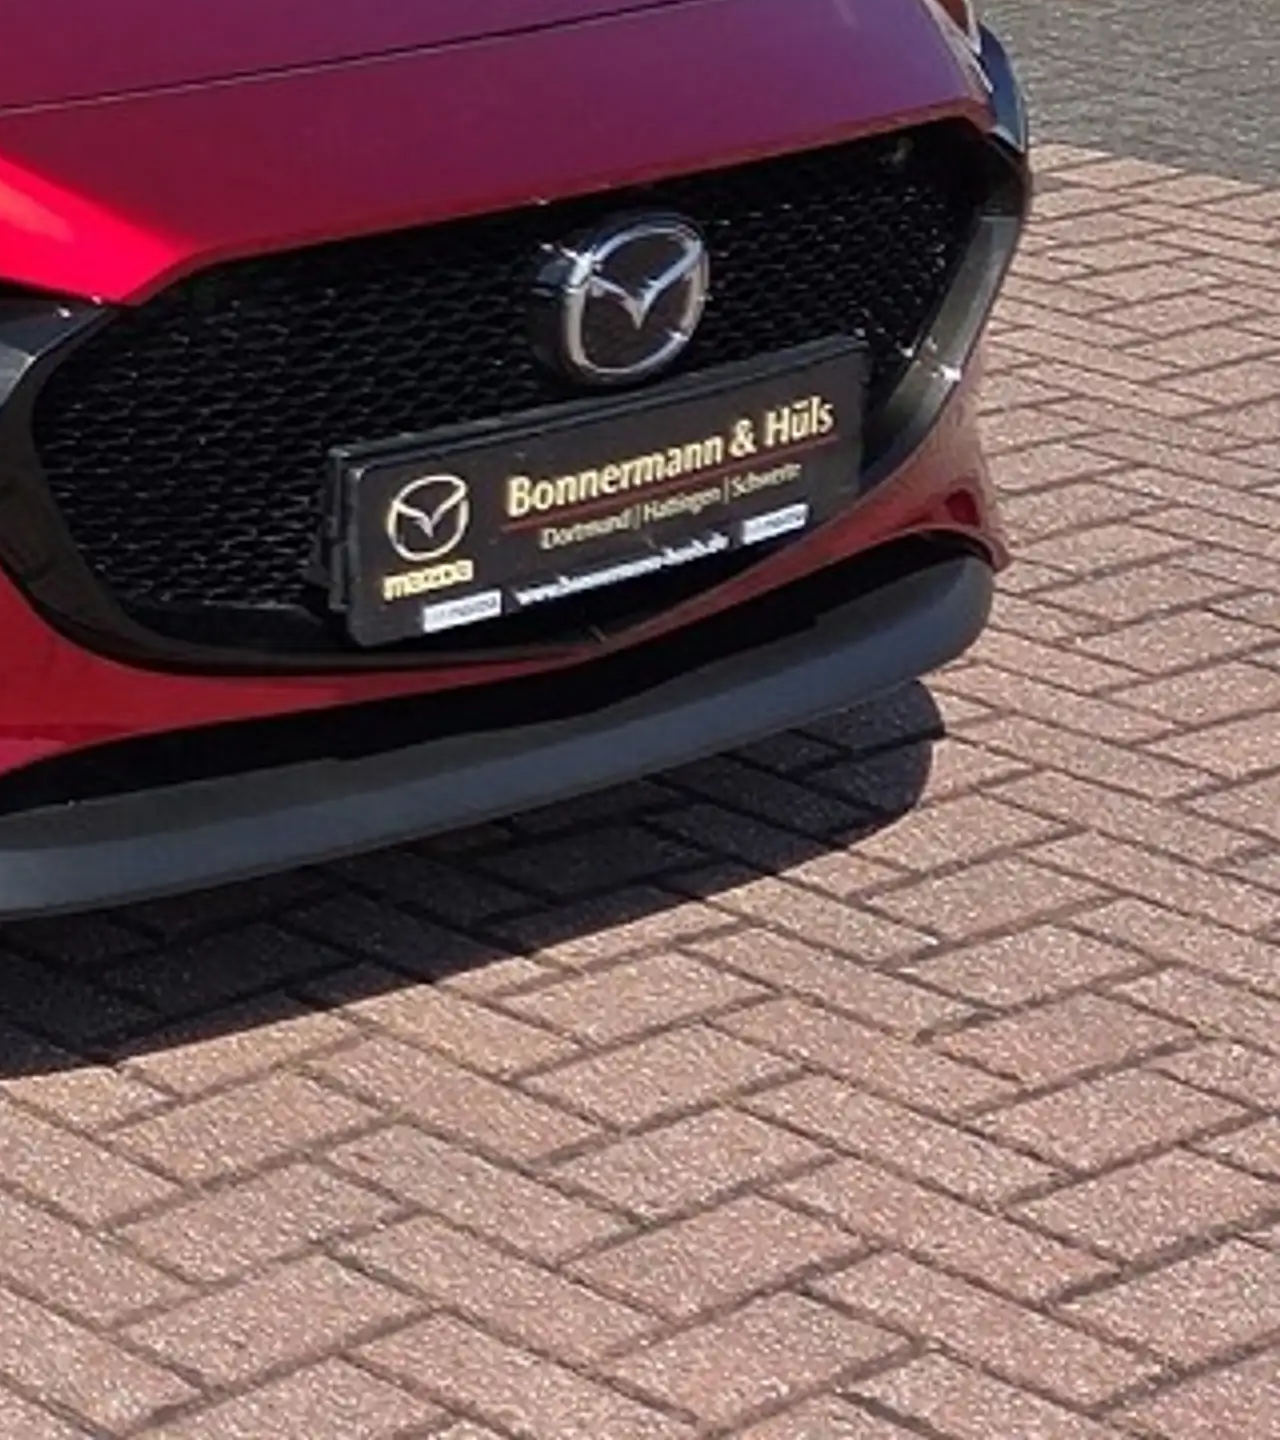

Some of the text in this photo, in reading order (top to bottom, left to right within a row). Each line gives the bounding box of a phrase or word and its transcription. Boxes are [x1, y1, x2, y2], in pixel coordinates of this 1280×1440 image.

[506, 395, 834, 518] Bonnermann & Hüls
[540, 508, 634, 550] Dortmund
[644, 486, 721, 523] Hattingen
